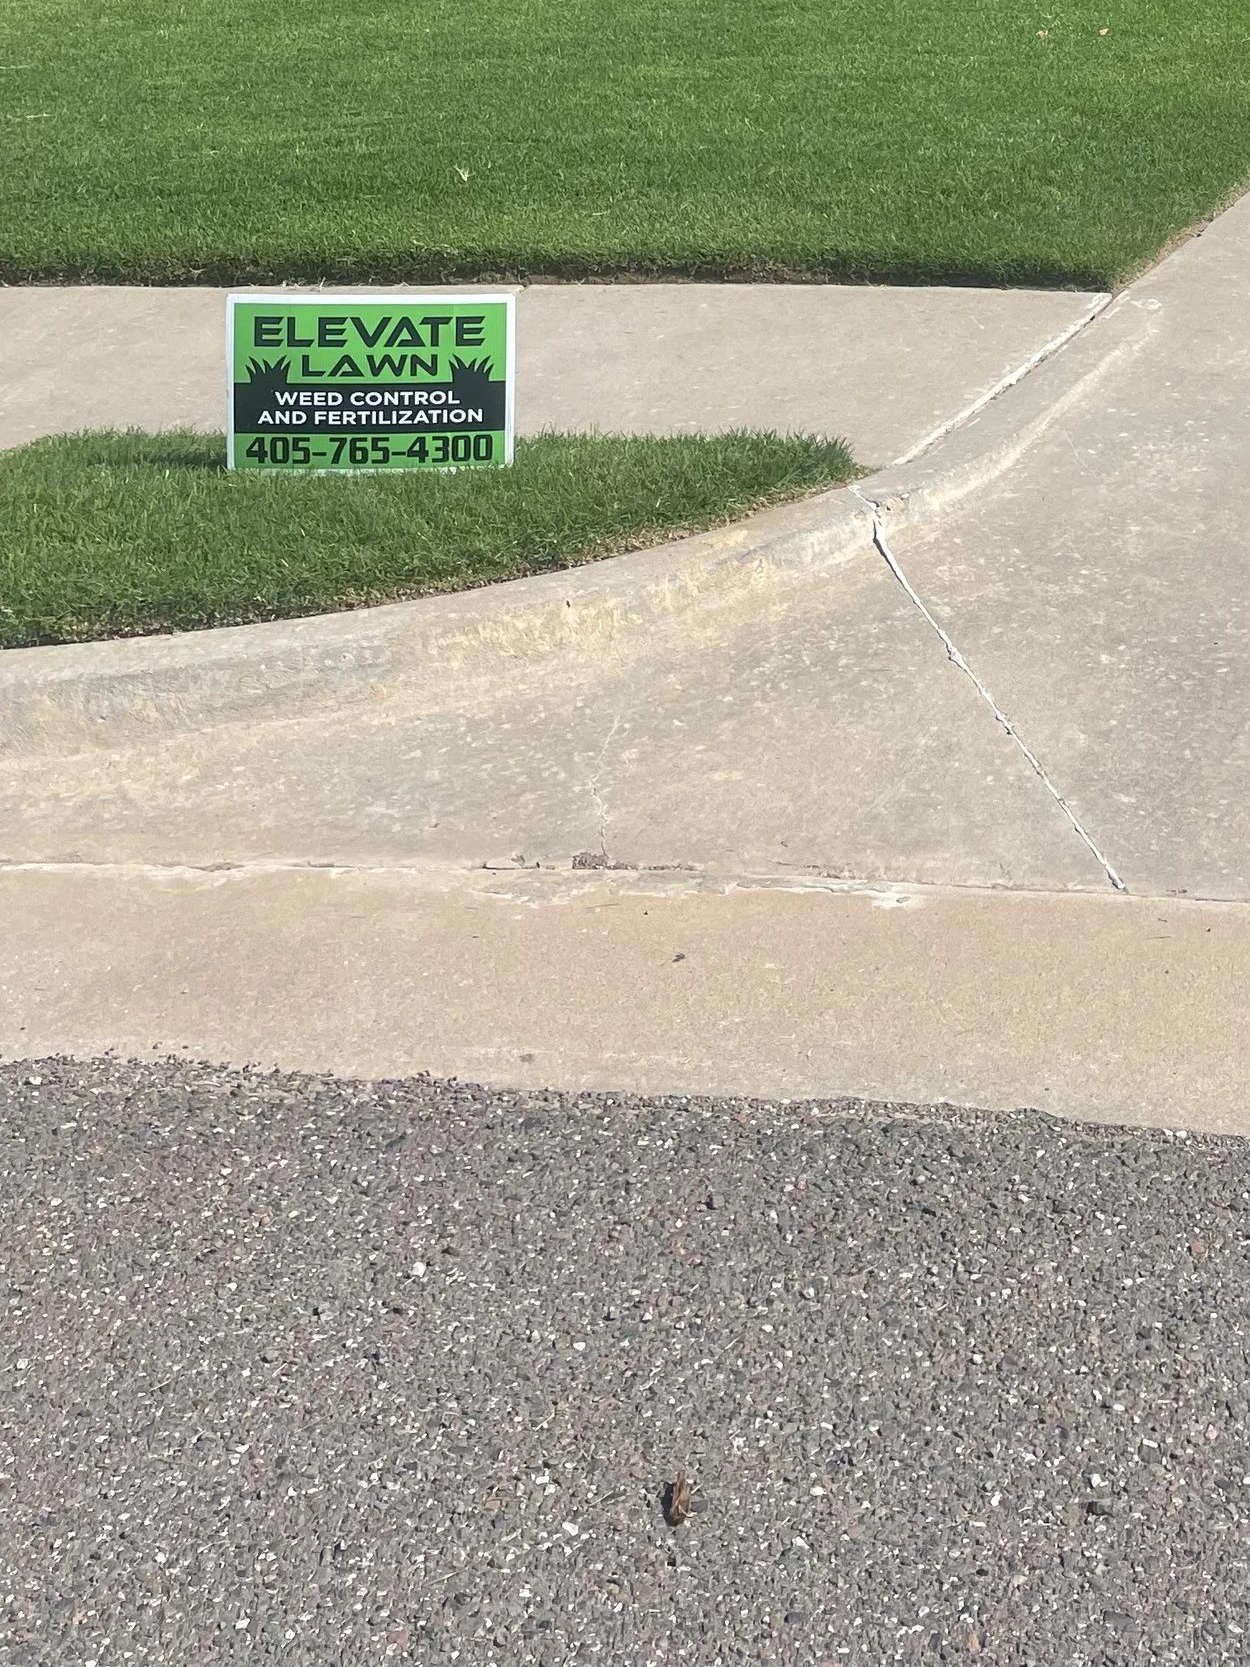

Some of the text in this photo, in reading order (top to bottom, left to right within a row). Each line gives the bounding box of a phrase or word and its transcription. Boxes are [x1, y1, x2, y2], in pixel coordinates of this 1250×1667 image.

[254, 316, 486, 348] ELEVATE
[301, 354, 438, 377] LAWN
[275, 390, 460, 406] WEED CONTROL
[258, 408, 483, 425] AND FERTILIZATION
[246, 435, 493, 465] 405-765-4300
